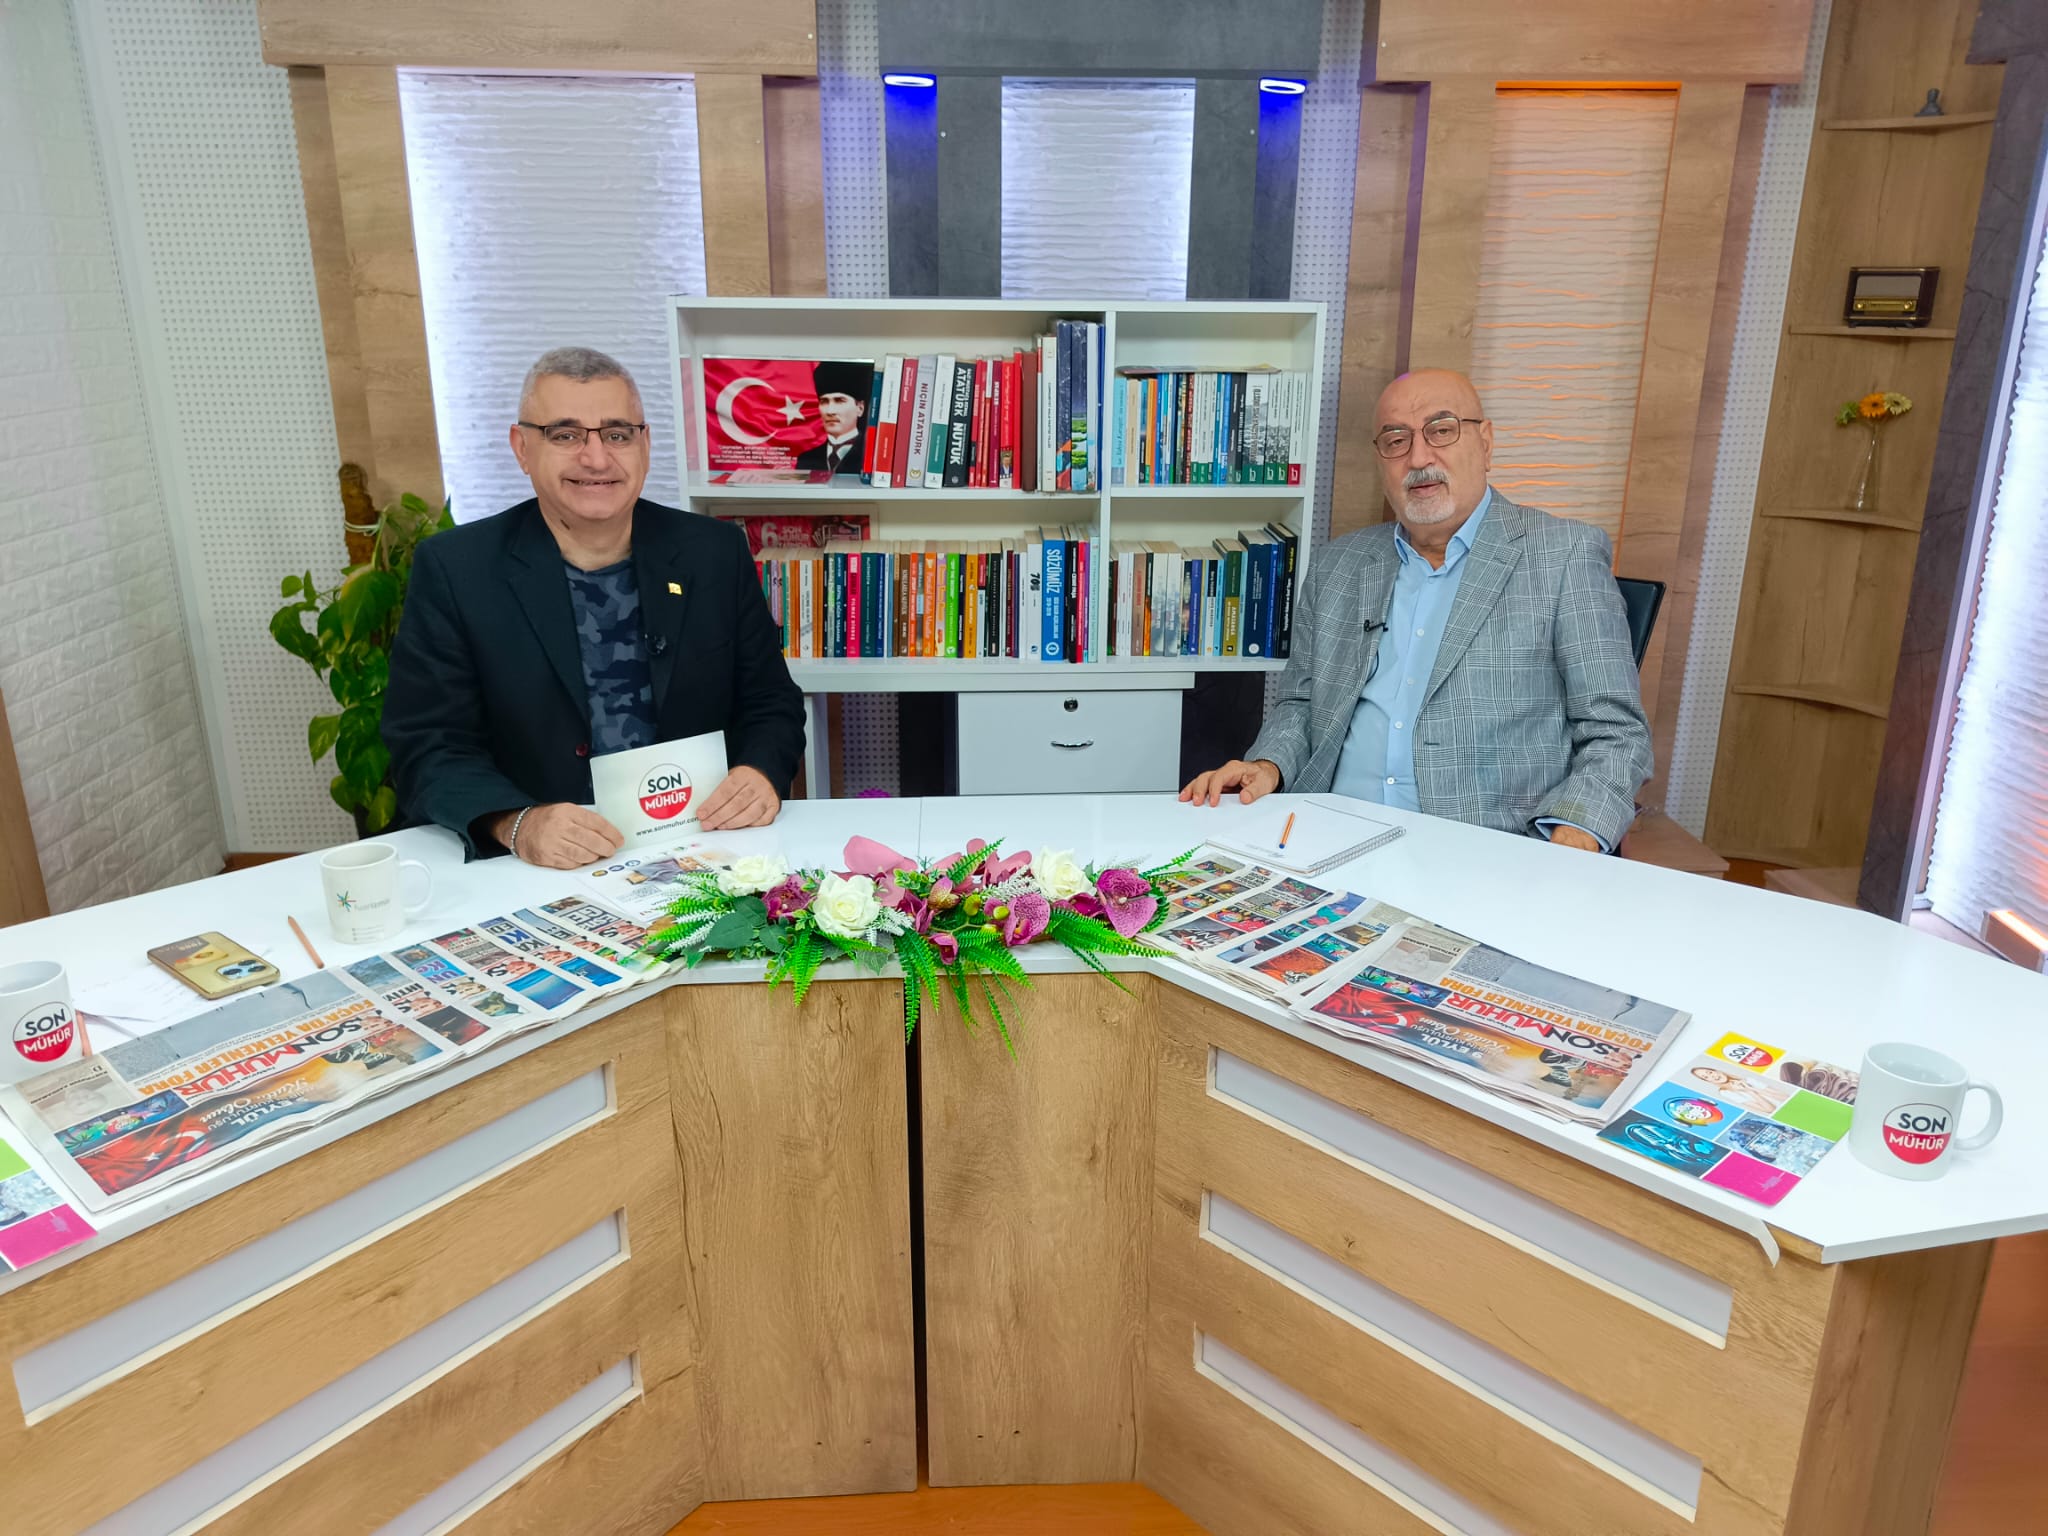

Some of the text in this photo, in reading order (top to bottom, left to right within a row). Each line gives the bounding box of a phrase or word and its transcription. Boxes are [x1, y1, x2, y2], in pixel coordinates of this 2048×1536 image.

[950, 367, 965, 465] ATATÜRK NUTUK
[914, 411, 926, 455] ATATÜRK
[1046, 549, 1063, 594] SÖZÜMÜZ
[648, 772, 682, 794] SON
[644, 791, 687, 811] MÜHÜR
[1438, 976, 1485, 999] FORA
[25, 1008, 66, 1036] SON
[1481, 991, 1575, 1029] YELKENLER
[1418, 1016, 1461, 1036] Olsun
[23, 1027, 72, 1054] MÜHÜR
[193, 1030, 298, 1072] YELKENLER
[1420, 1033, 1471, 1054] EYLÜL
[137, 1069, 196, 1096] FORA
[1897, 1113, 1947, 1133] SON
[1889, 1132, 1945, 1151] MÜHÜR
